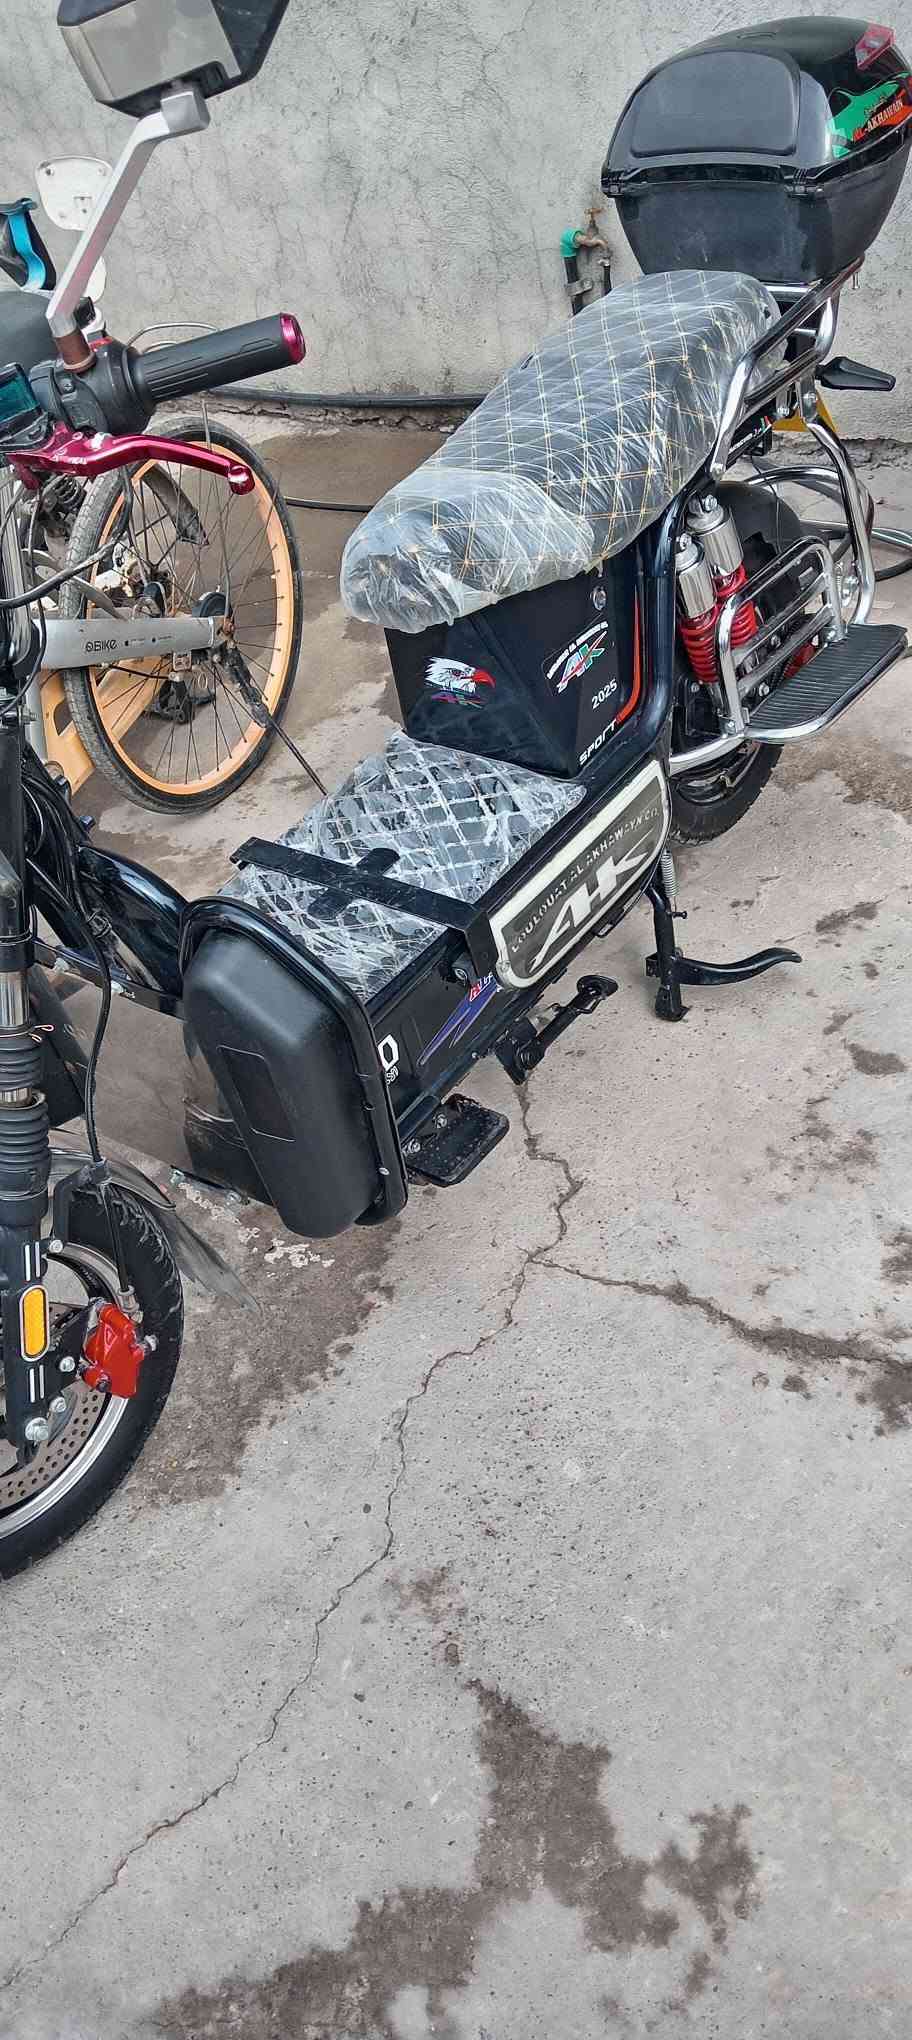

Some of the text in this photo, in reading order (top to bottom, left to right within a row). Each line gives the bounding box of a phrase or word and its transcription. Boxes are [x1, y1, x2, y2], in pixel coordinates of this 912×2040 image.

[591, 678, 618, 710] 2025
[511, 880, 569, 954] LOULOUAT
[569, 865, 585, 882] AL
[586, 817, 643, 866] AKHAWAYN
